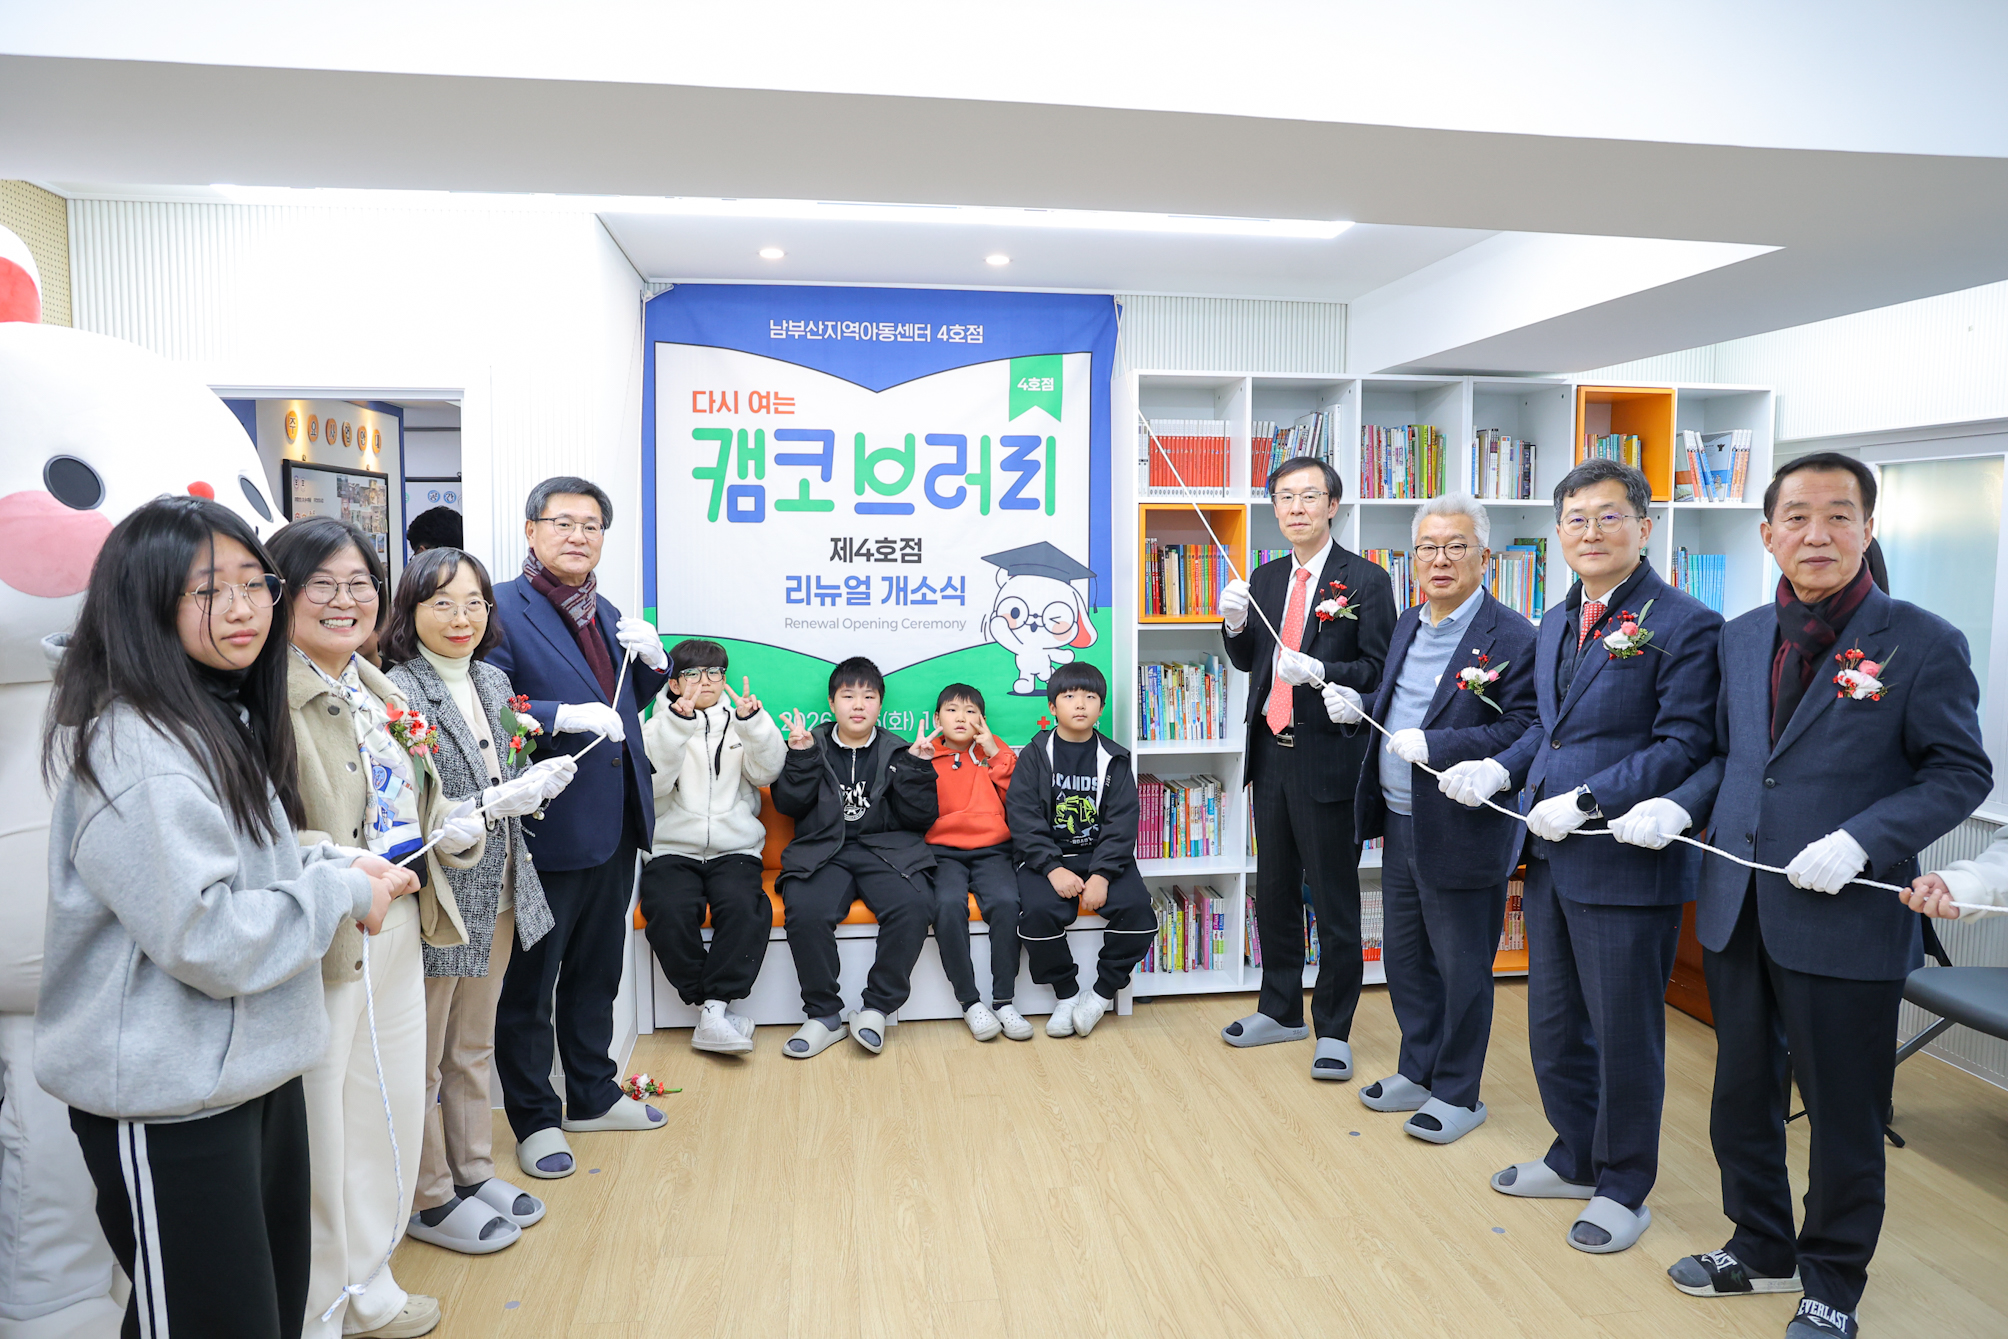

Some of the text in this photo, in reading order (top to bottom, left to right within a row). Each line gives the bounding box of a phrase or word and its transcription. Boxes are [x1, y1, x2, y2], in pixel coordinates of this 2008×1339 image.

[769, 319, 984, 344] 남부산지역아동센터 4호점
[1016, 377, 1055, 392] 4호점
[692, 390, 796, 415] 다시 여는
[829, 536, 923, 564] 제4호점
[785, 574, 966, 607] 리뉴얼 개소식
[784, 617, 967, 632] Renewal Opening Ceremony
[1797, 1298, 1849, 1334] EVERLAST
